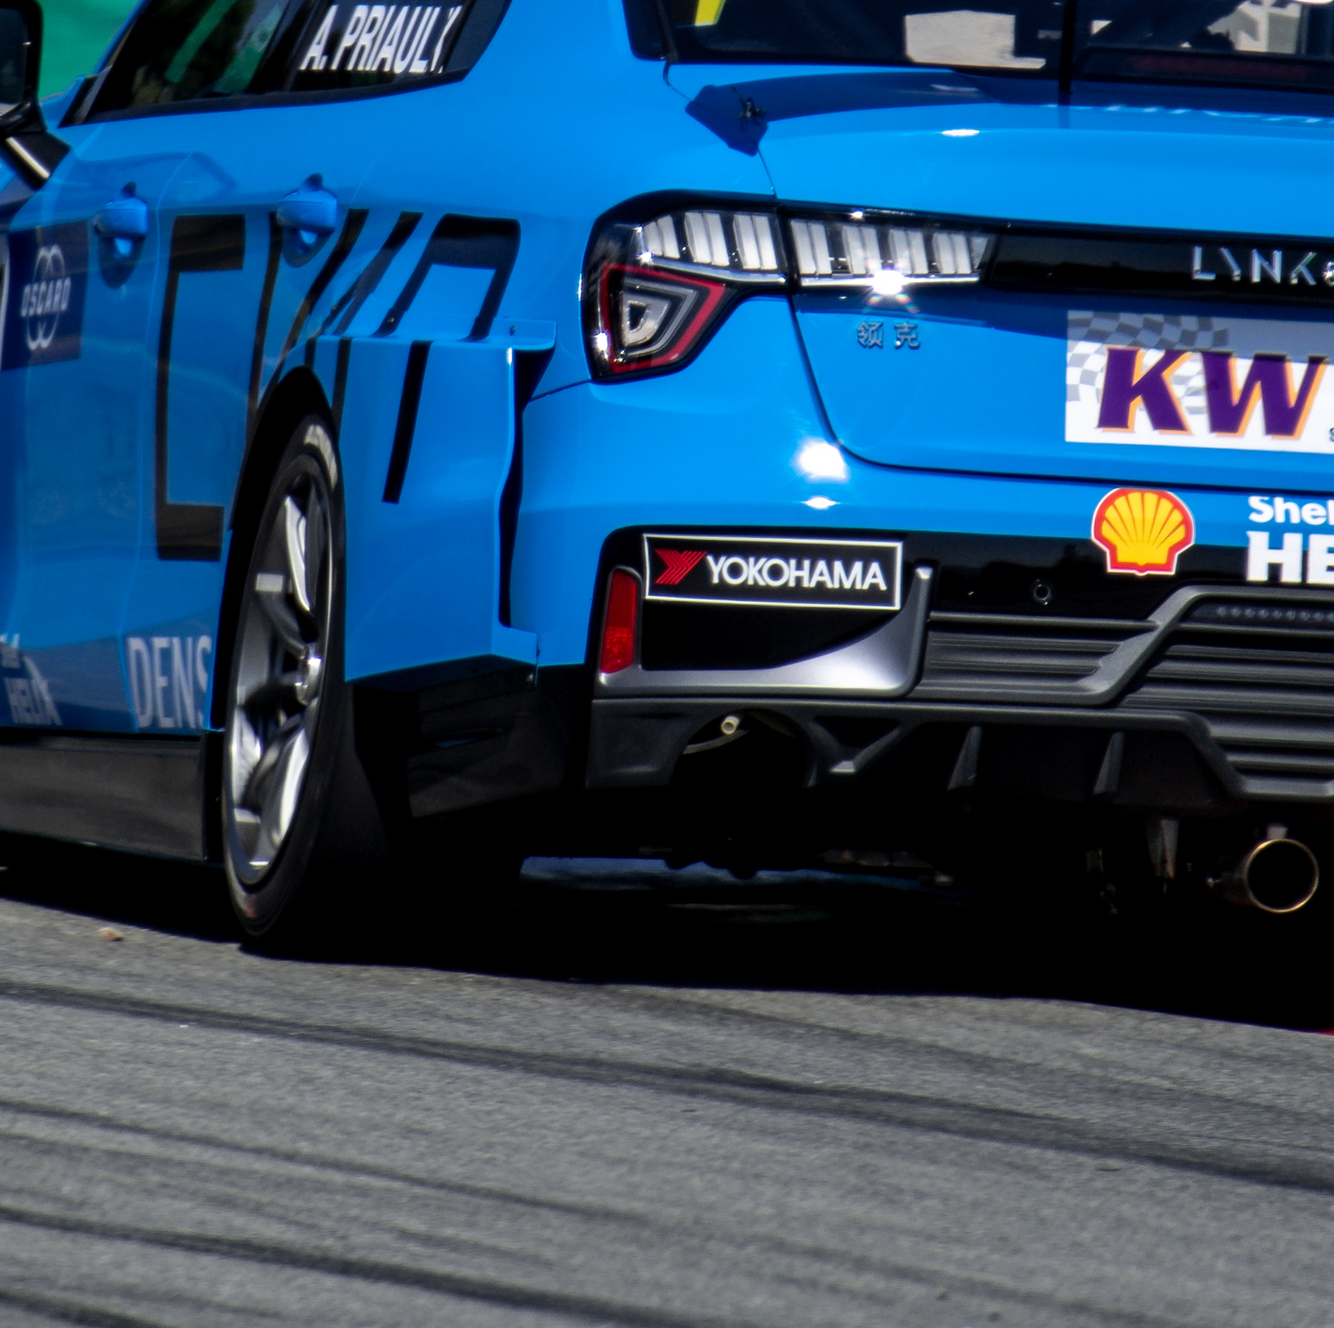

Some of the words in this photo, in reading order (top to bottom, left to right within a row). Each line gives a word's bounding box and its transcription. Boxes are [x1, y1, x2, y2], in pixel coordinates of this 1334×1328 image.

[299, 4, 338, 71] A.
[20, 276, 72, 319] OSCARO
[857, 321, 921, 350] 领克
[1097, 345, 1331, 441] KW
[707, 555, 888, 592] YOKOHAMA
